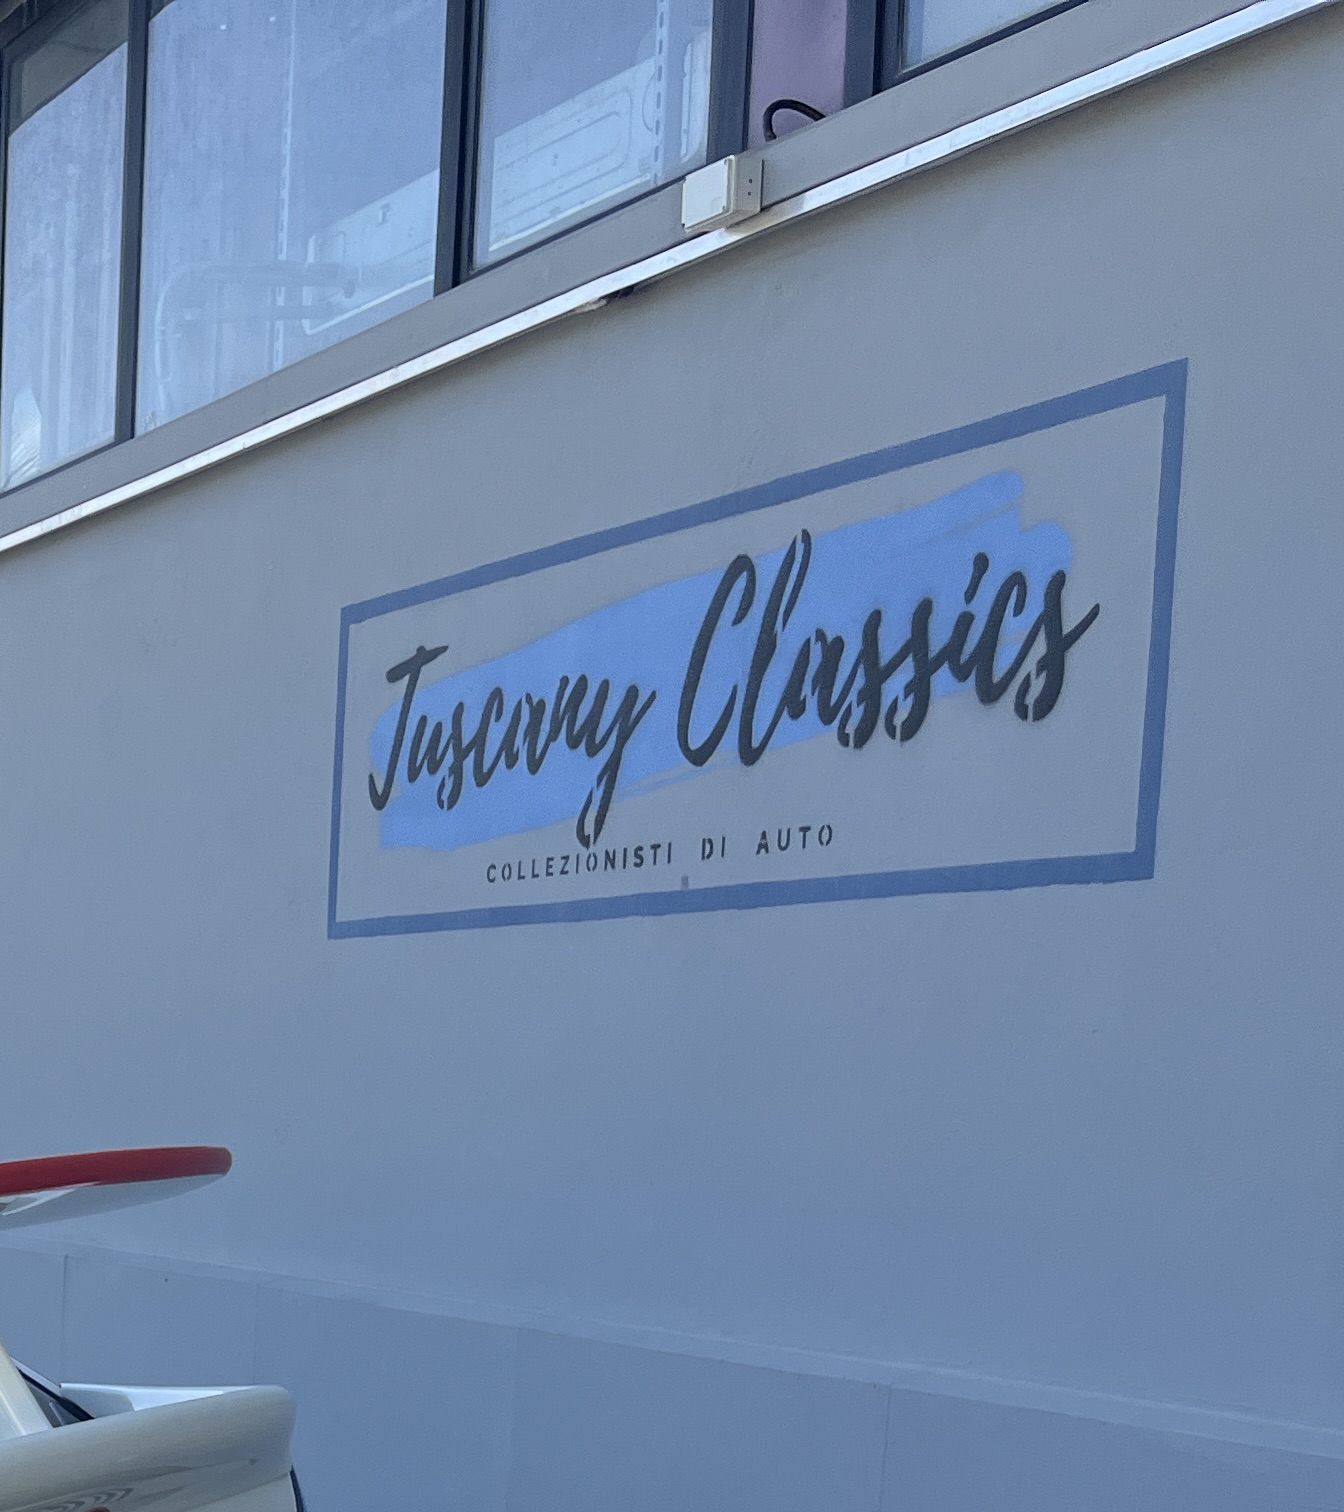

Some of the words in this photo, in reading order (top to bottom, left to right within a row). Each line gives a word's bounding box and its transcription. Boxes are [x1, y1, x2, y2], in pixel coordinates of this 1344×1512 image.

[369, 645, 659, 848] Tuscany
[677, 529, 1100, 766] Classics
[486, 841, 673, 884] COLLEZIONISTI
[701, 836, 728, 861] DI
[756, 824, 834, 855] AUTO
